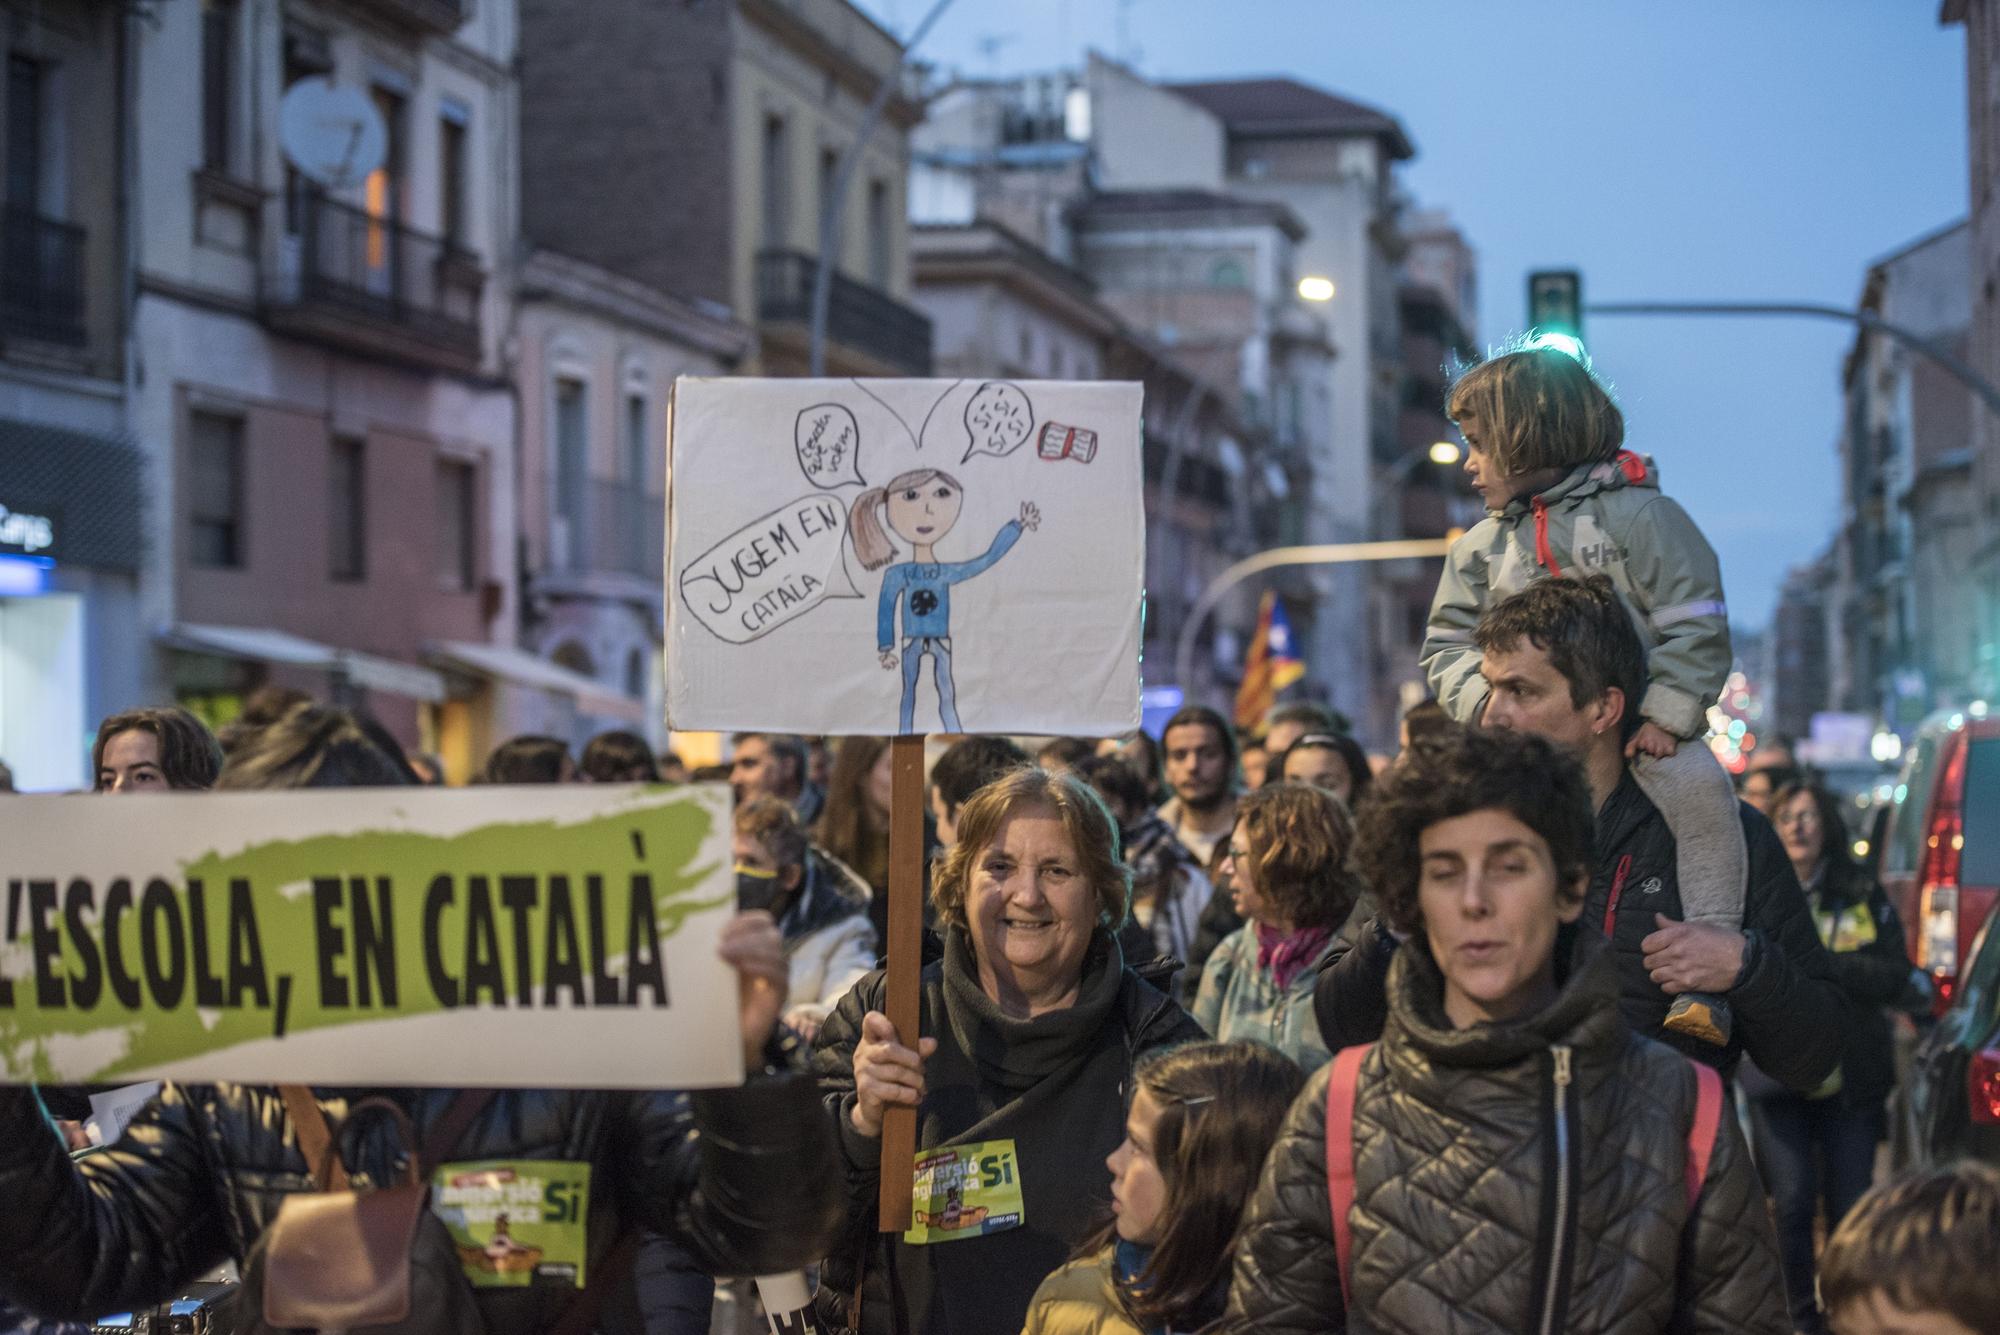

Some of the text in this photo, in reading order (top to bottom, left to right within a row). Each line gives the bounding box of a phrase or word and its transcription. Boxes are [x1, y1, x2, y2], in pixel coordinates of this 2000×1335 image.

[683, 503, 838, 614] JUGEM EN
[312, 874, 399, 1009] EN
[422, 829, 670, 1009] CATALÀ
[544, 1181, 581, 1224] Sí
[980, 1152, 1013, 1187] Sí
